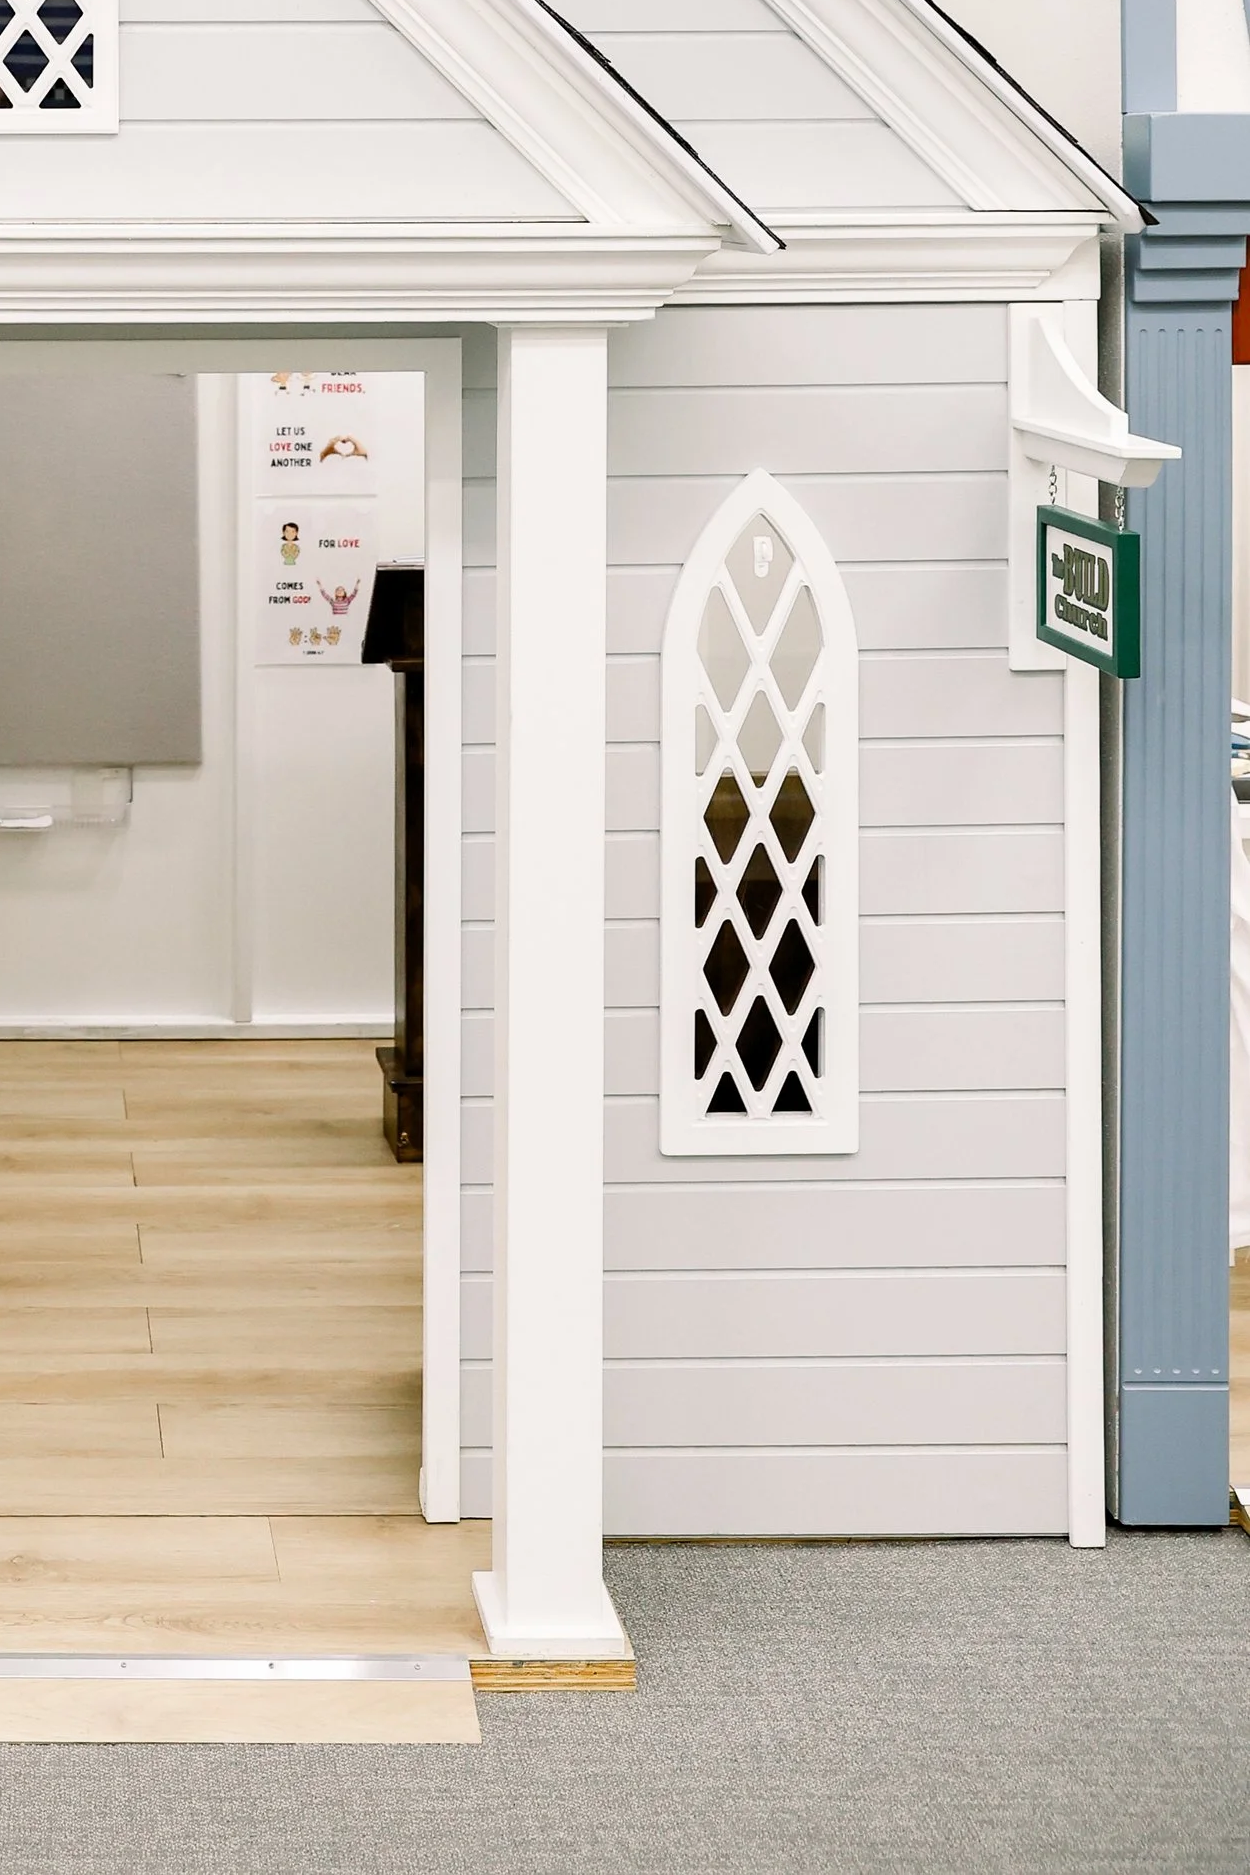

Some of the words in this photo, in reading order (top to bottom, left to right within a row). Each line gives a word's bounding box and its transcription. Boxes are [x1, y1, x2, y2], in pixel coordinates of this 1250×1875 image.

[276, 427, 291, 436] LET
[293, 427, 305, 436] US
[269, 442, 291, 451] LOVE
[294, 442, 312, 451] ONE
[270, 458, 312, 467] ANOTHER
[318, 539, 336, 548] FOR
[337, 539, 360, 548] LOVE
[1063, 543, 1109, 612] BUILD
[276, 582, 304, 590] COMES
[268, 596, 291, 604] FROM
[1054, 593, 1108, 642] Church
